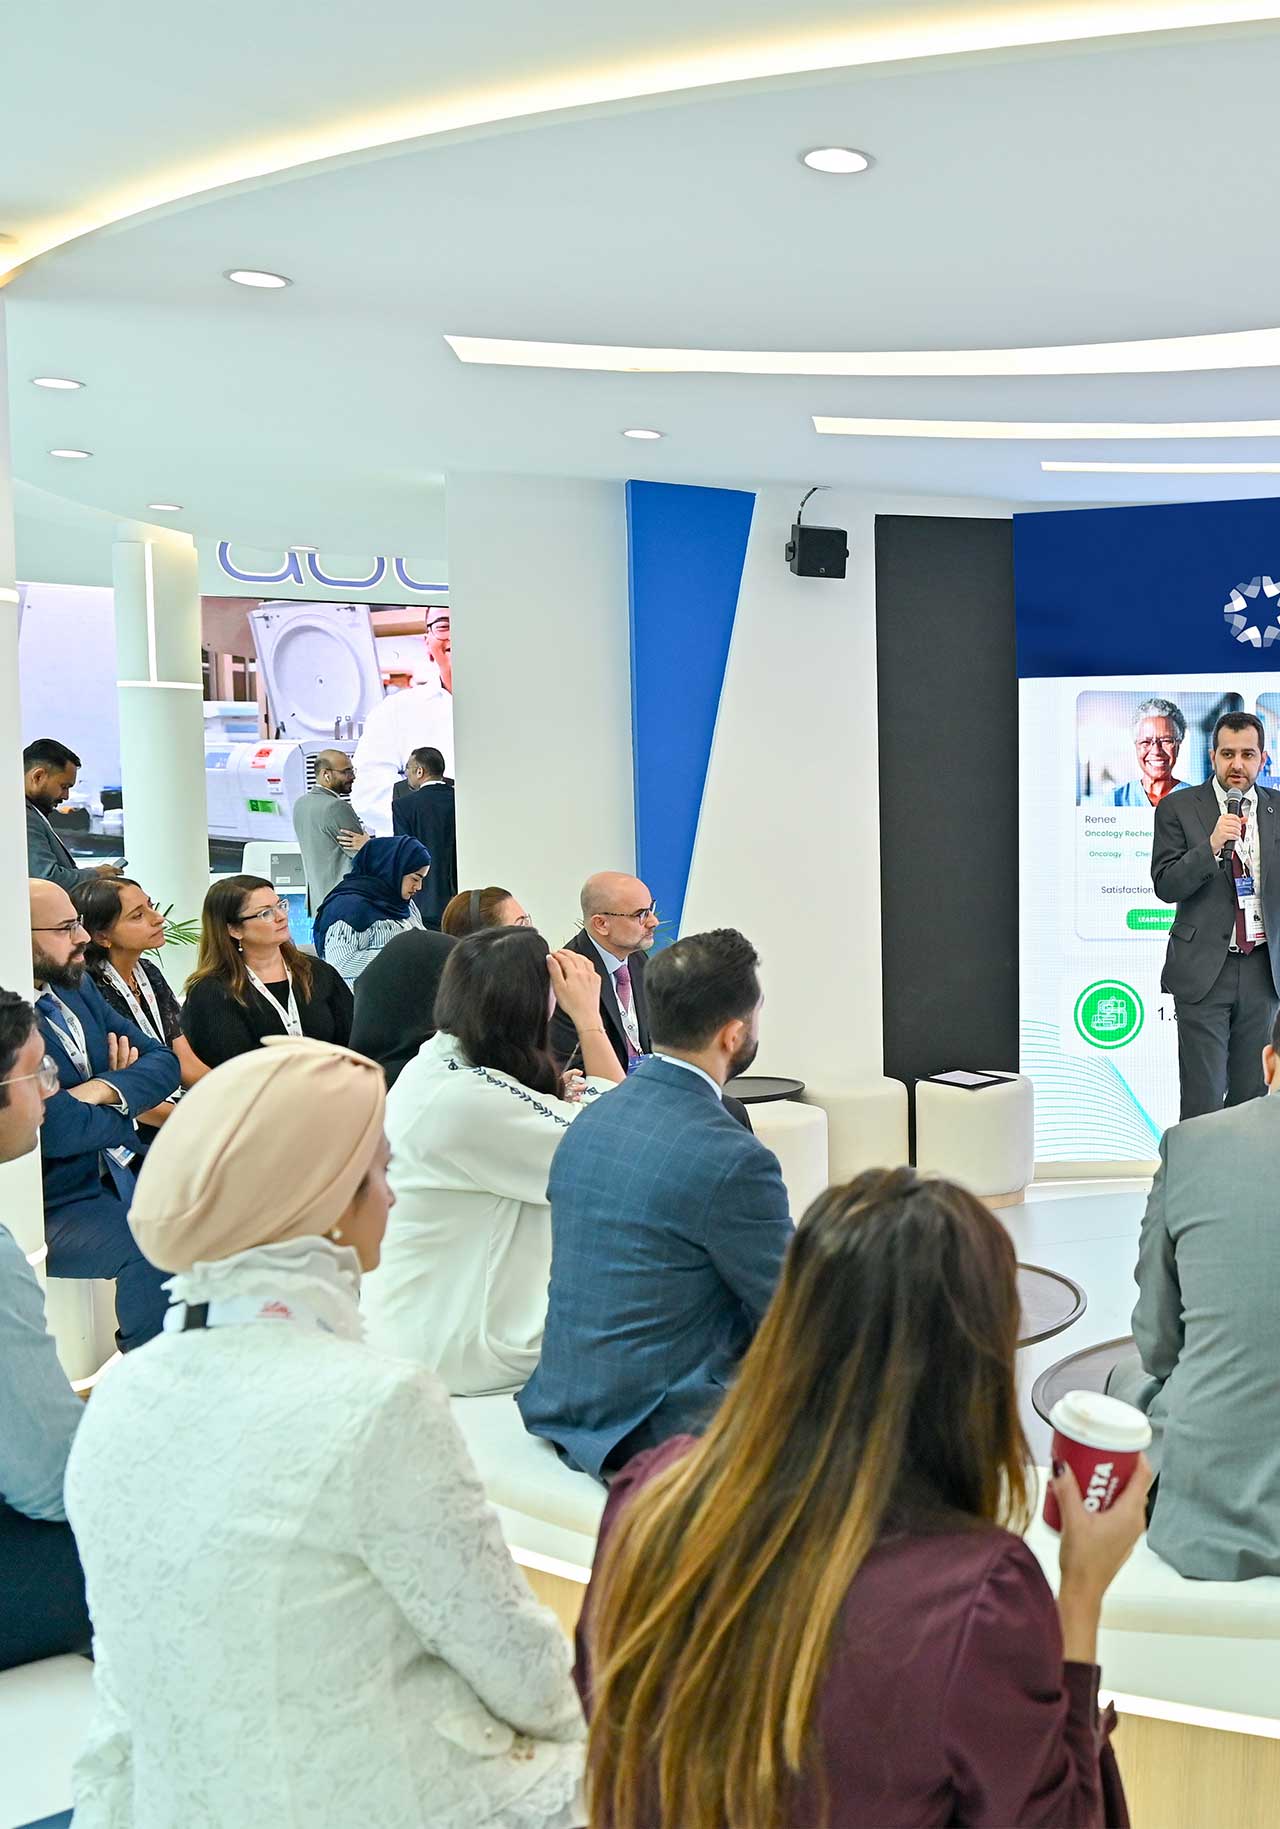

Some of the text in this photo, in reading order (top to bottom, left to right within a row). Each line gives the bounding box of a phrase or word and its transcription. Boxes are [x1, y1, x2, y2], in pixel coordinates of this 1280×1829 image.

[1084, 815, 1116, 824] Renee
[1084, 830, 1123, 839] Oncology
[1089, 850, 1122, 858] Oncology
[1100, 886, 1154, 894] Satisfaction
